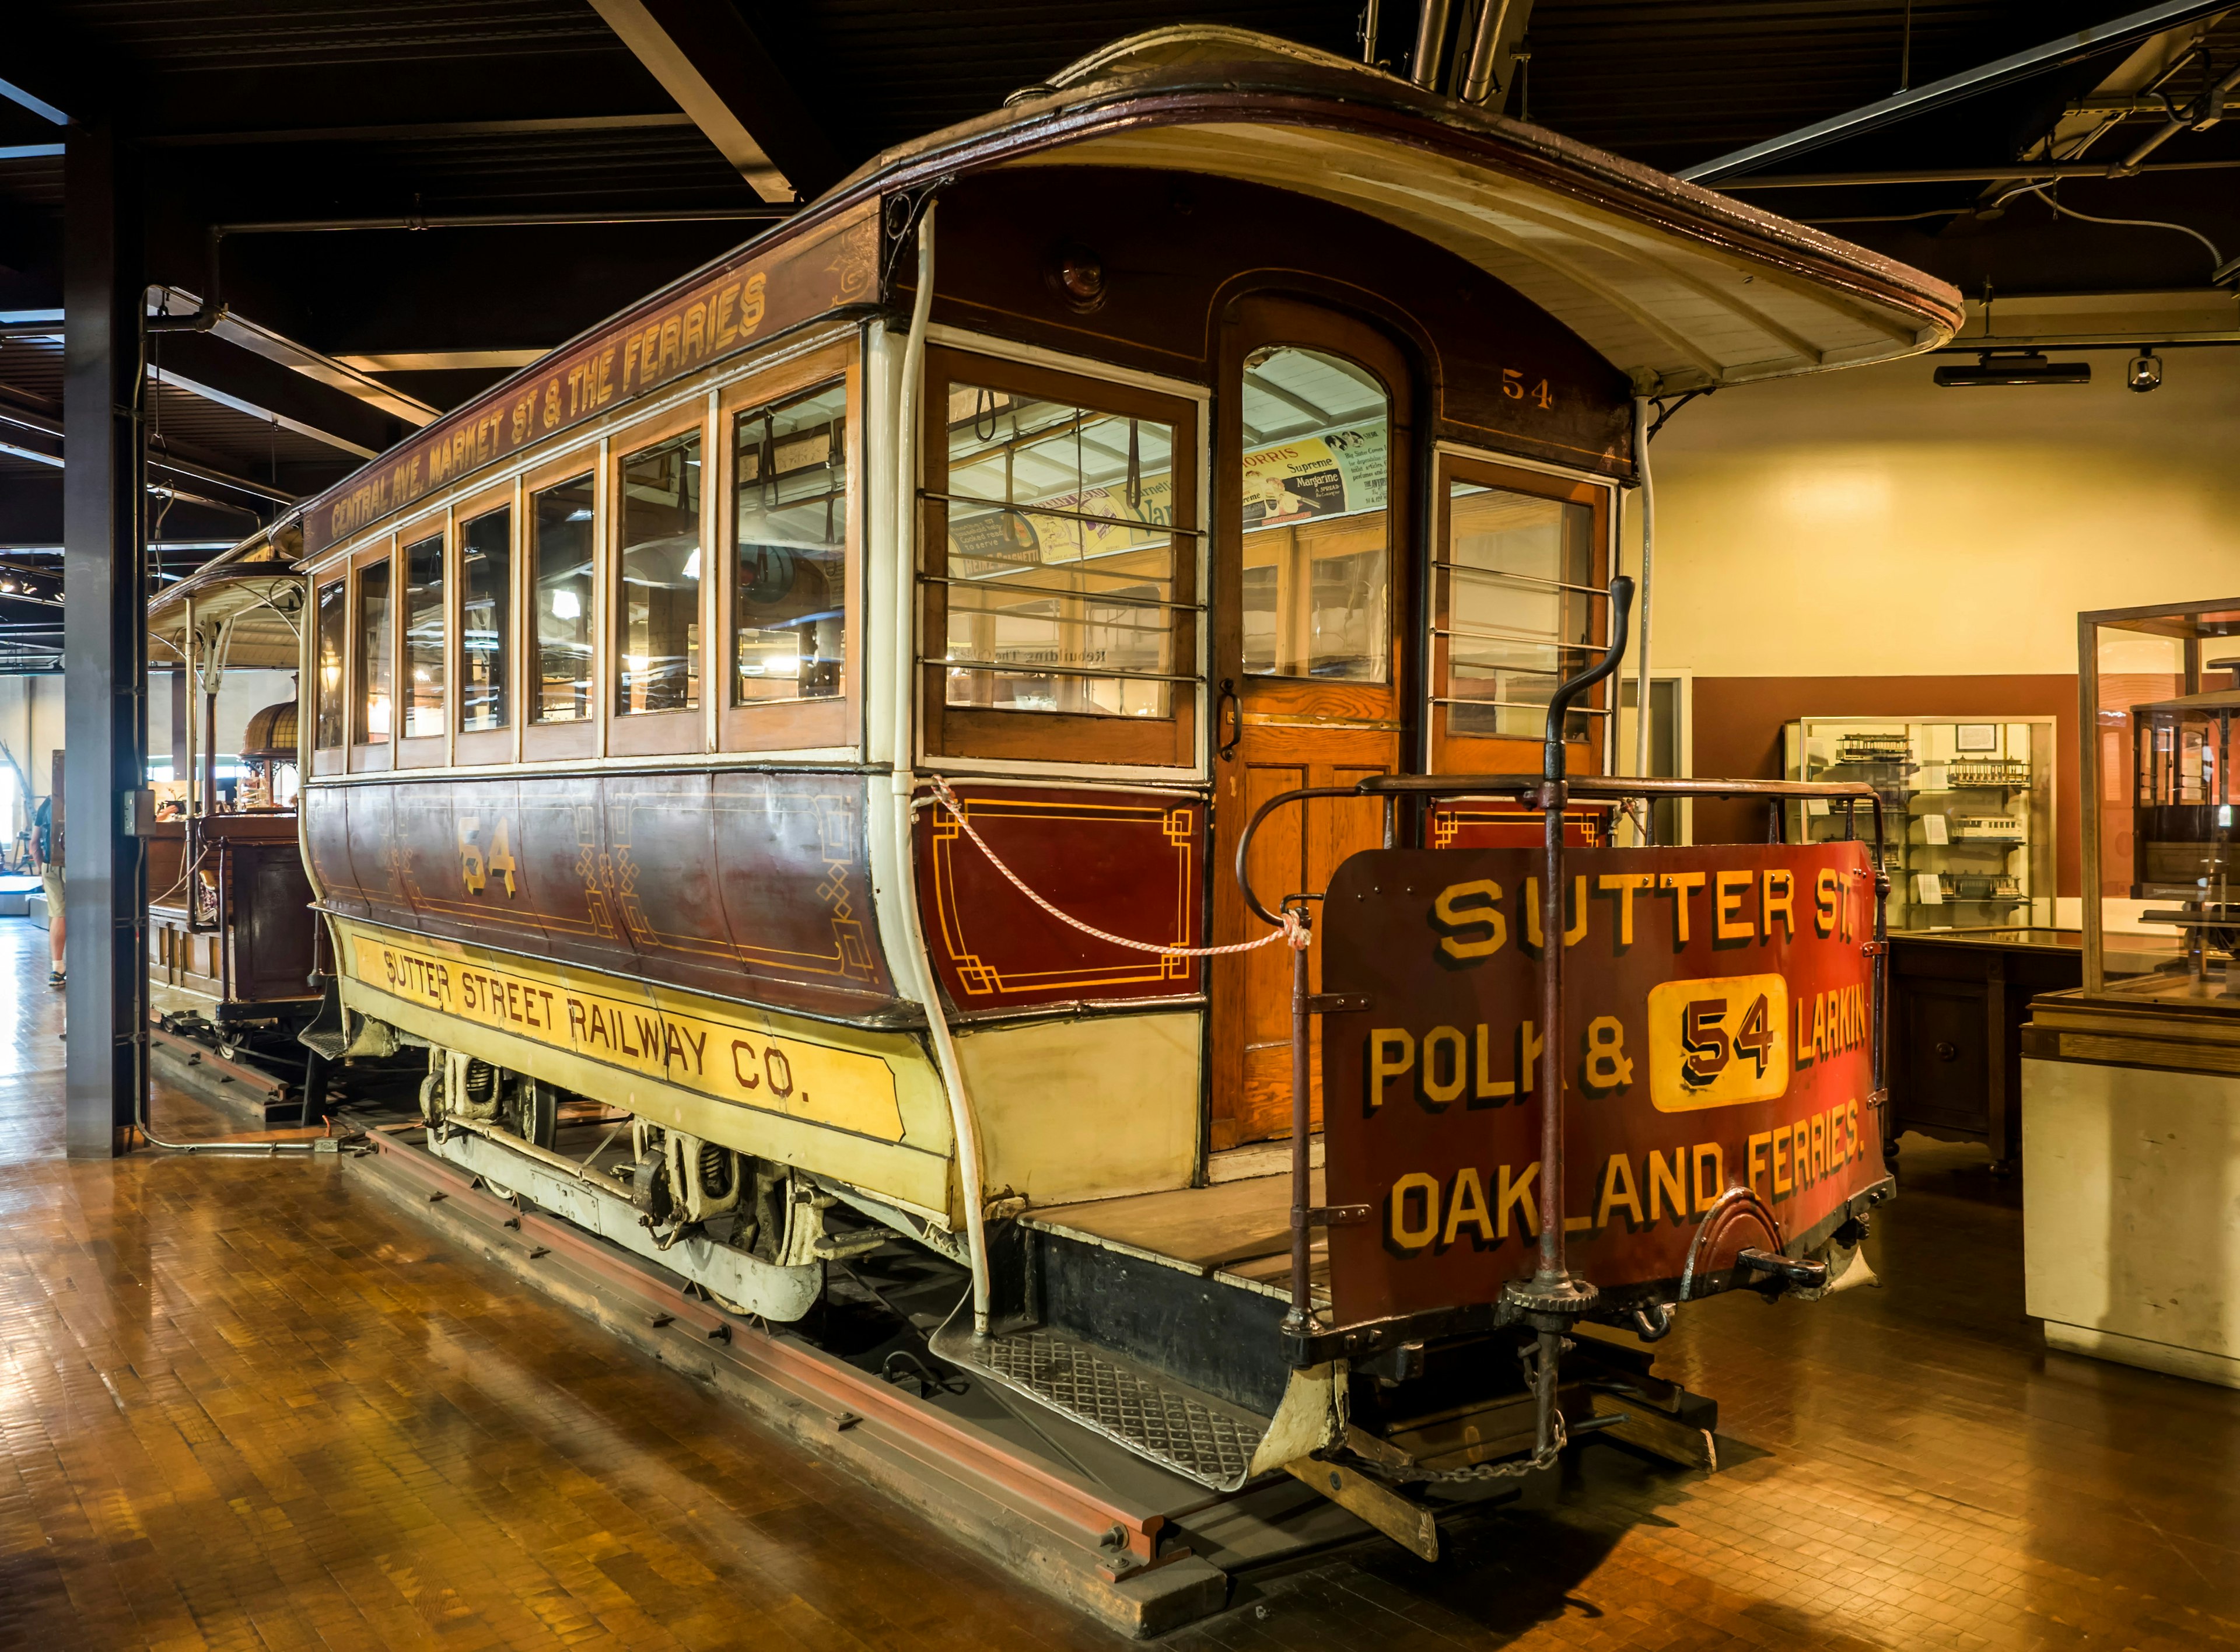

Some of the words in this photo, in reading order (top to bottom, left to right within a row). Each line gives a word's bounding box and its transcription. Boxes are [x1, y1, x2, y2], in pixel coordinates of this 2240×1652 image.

[332, 486, 389, 539] CENTRAL
[391, 456, 425, 510] AVE.
[429, 409, 505, 485] MARKET
[512, 390, 537, 444] ST
[543, 379, 561, 428] &
[568, 351, 614, 412] THE
[624, 271, 767, 392] FERRIES
[1503, 369, 1553, 410] 54
[1287, 458, 1334, 473] Supreme
[1296, 473, 1339, 488] Margarine
[960, 533, 986, 543] Cooked
[975, 540, 999, 549] serve
[459, 817, 516, 899] 54
[1433, 869, 1795, 961] SUTTER
[1815, 868, 1853, 943] ST.
[385, 951, 450, 1003] SUTTER
[464, 972, 554, 1030] STREET
[570, 998, 707, 1076] RAILWAY
[730, 1040, 808, 1102] CO.
[1584, 1016, 1633, 1090] &
[1680, 993, 1774, 1087] 54
[1796, 982, 1866, 1065] LARKIN
[1748, 1098, 1864, 1204] FERRIES.
